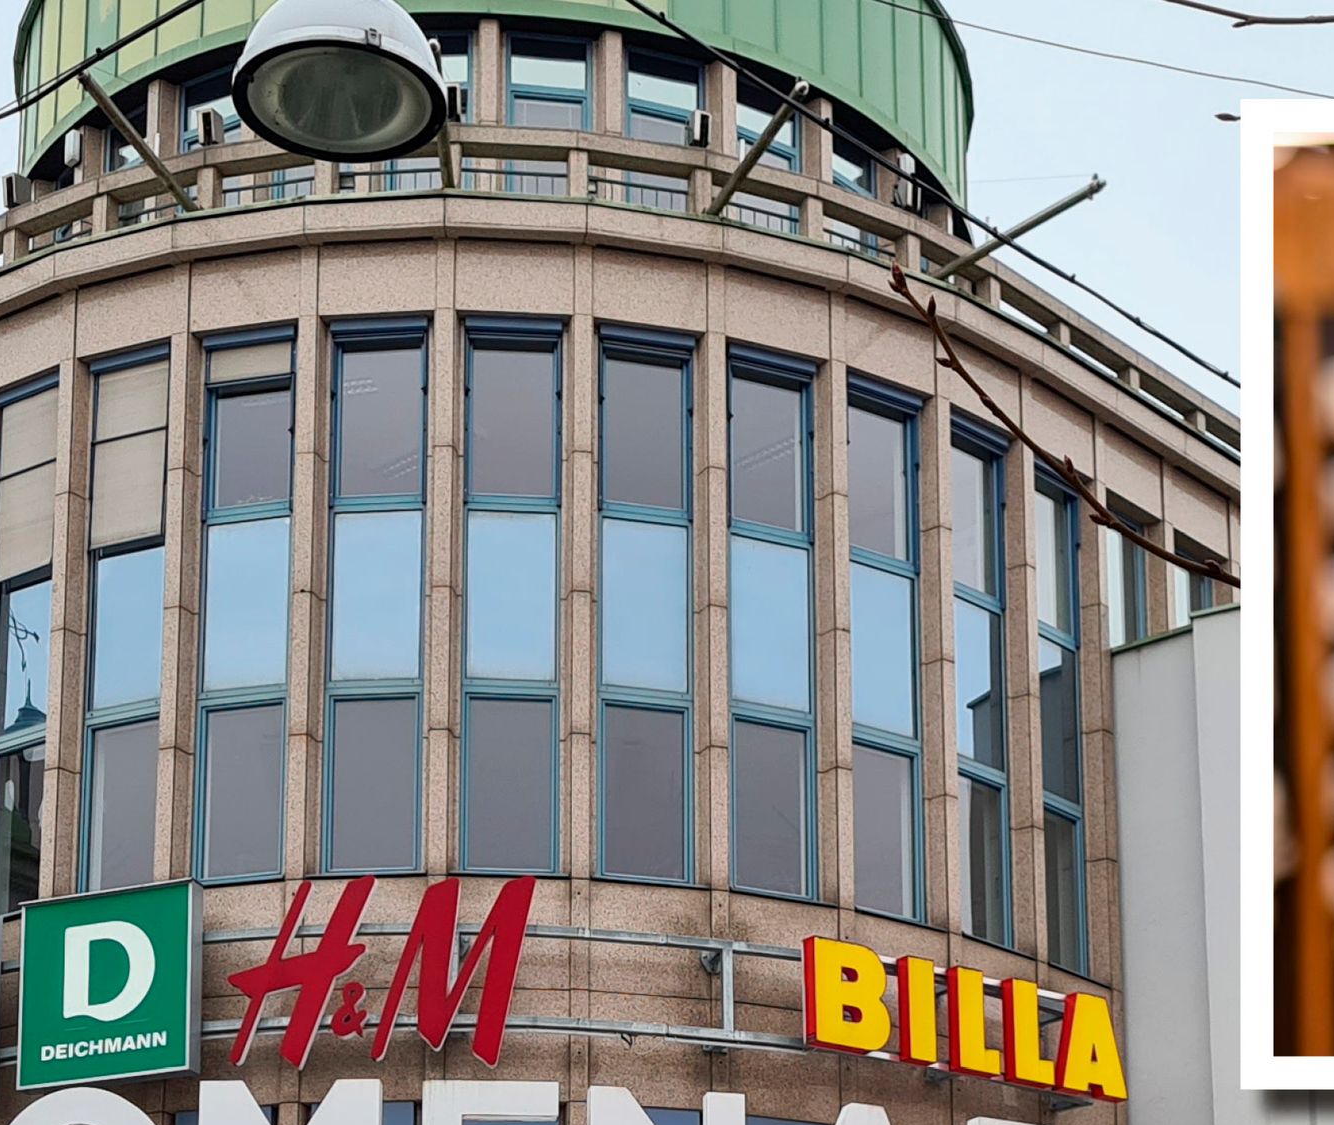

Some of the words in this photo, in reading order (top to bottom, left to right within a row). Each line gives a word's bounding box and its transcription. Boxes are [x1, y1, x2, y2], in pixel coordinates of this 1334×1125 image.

[63, 920, 156, 1022] D
[228, 875, 536, 1070] H&M
[803, 934, 1128, 1102] BILLA
[40, 1031, 167, 1062] DEICHMANN
